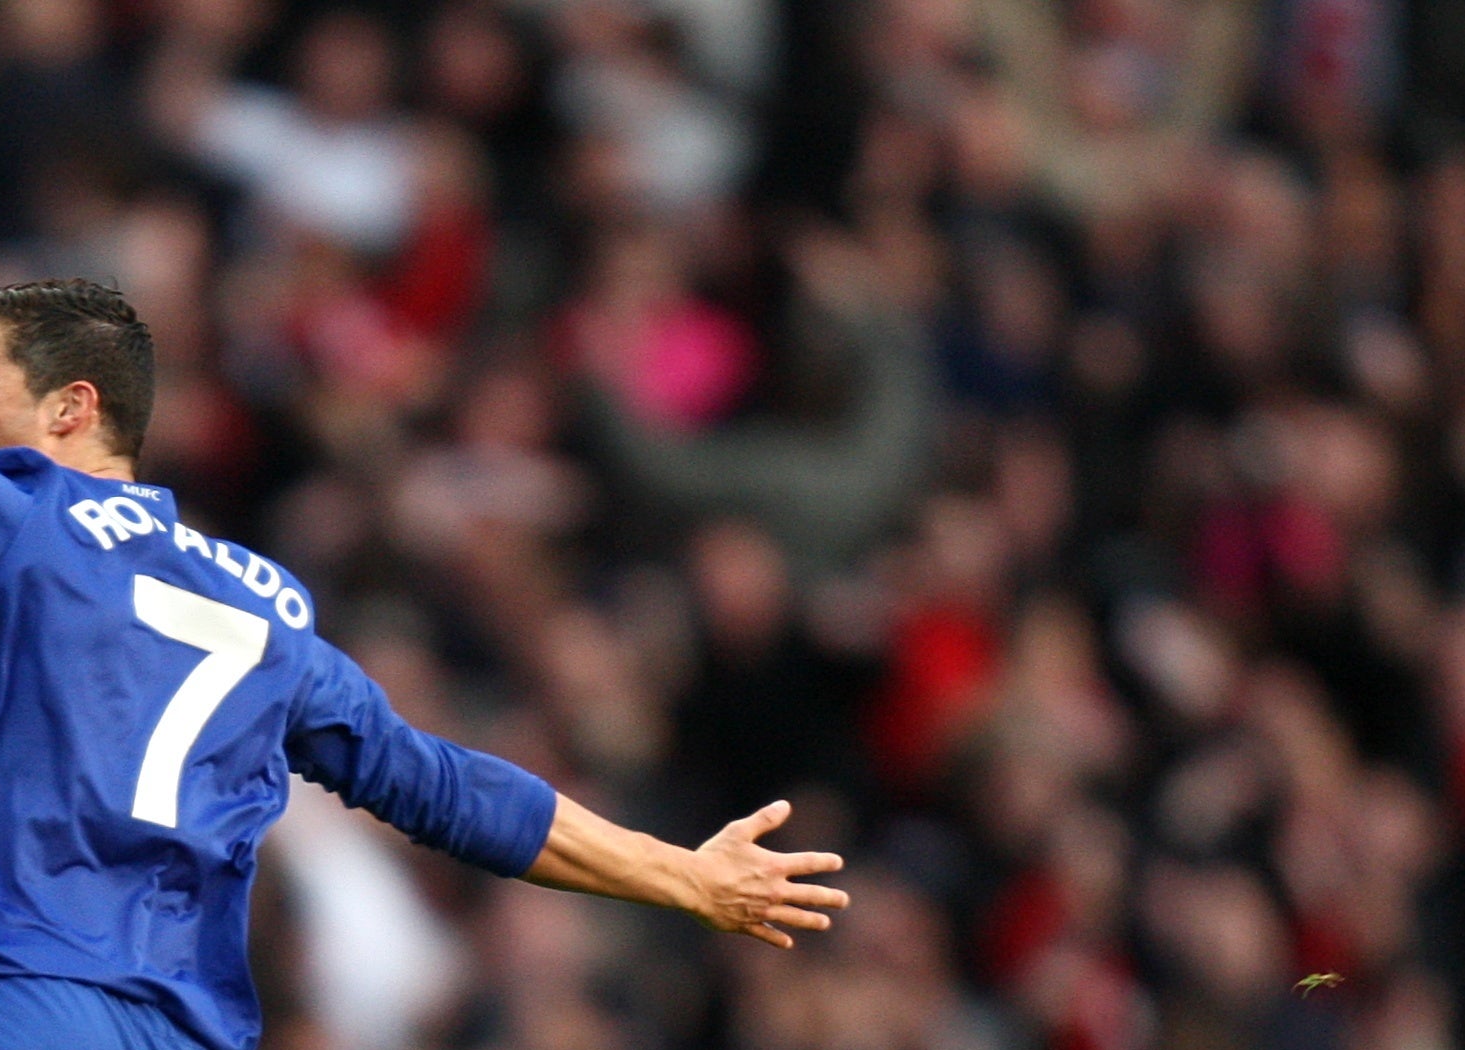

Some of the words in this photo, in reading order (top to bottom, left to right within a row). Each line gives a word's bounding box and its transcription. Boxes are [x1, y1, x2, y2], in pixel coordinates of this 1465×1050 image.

[121, 483, 162, 502] MUFC
[69, 496, 309, 630] ROALDO
[131, 574, 269, 828] 7
